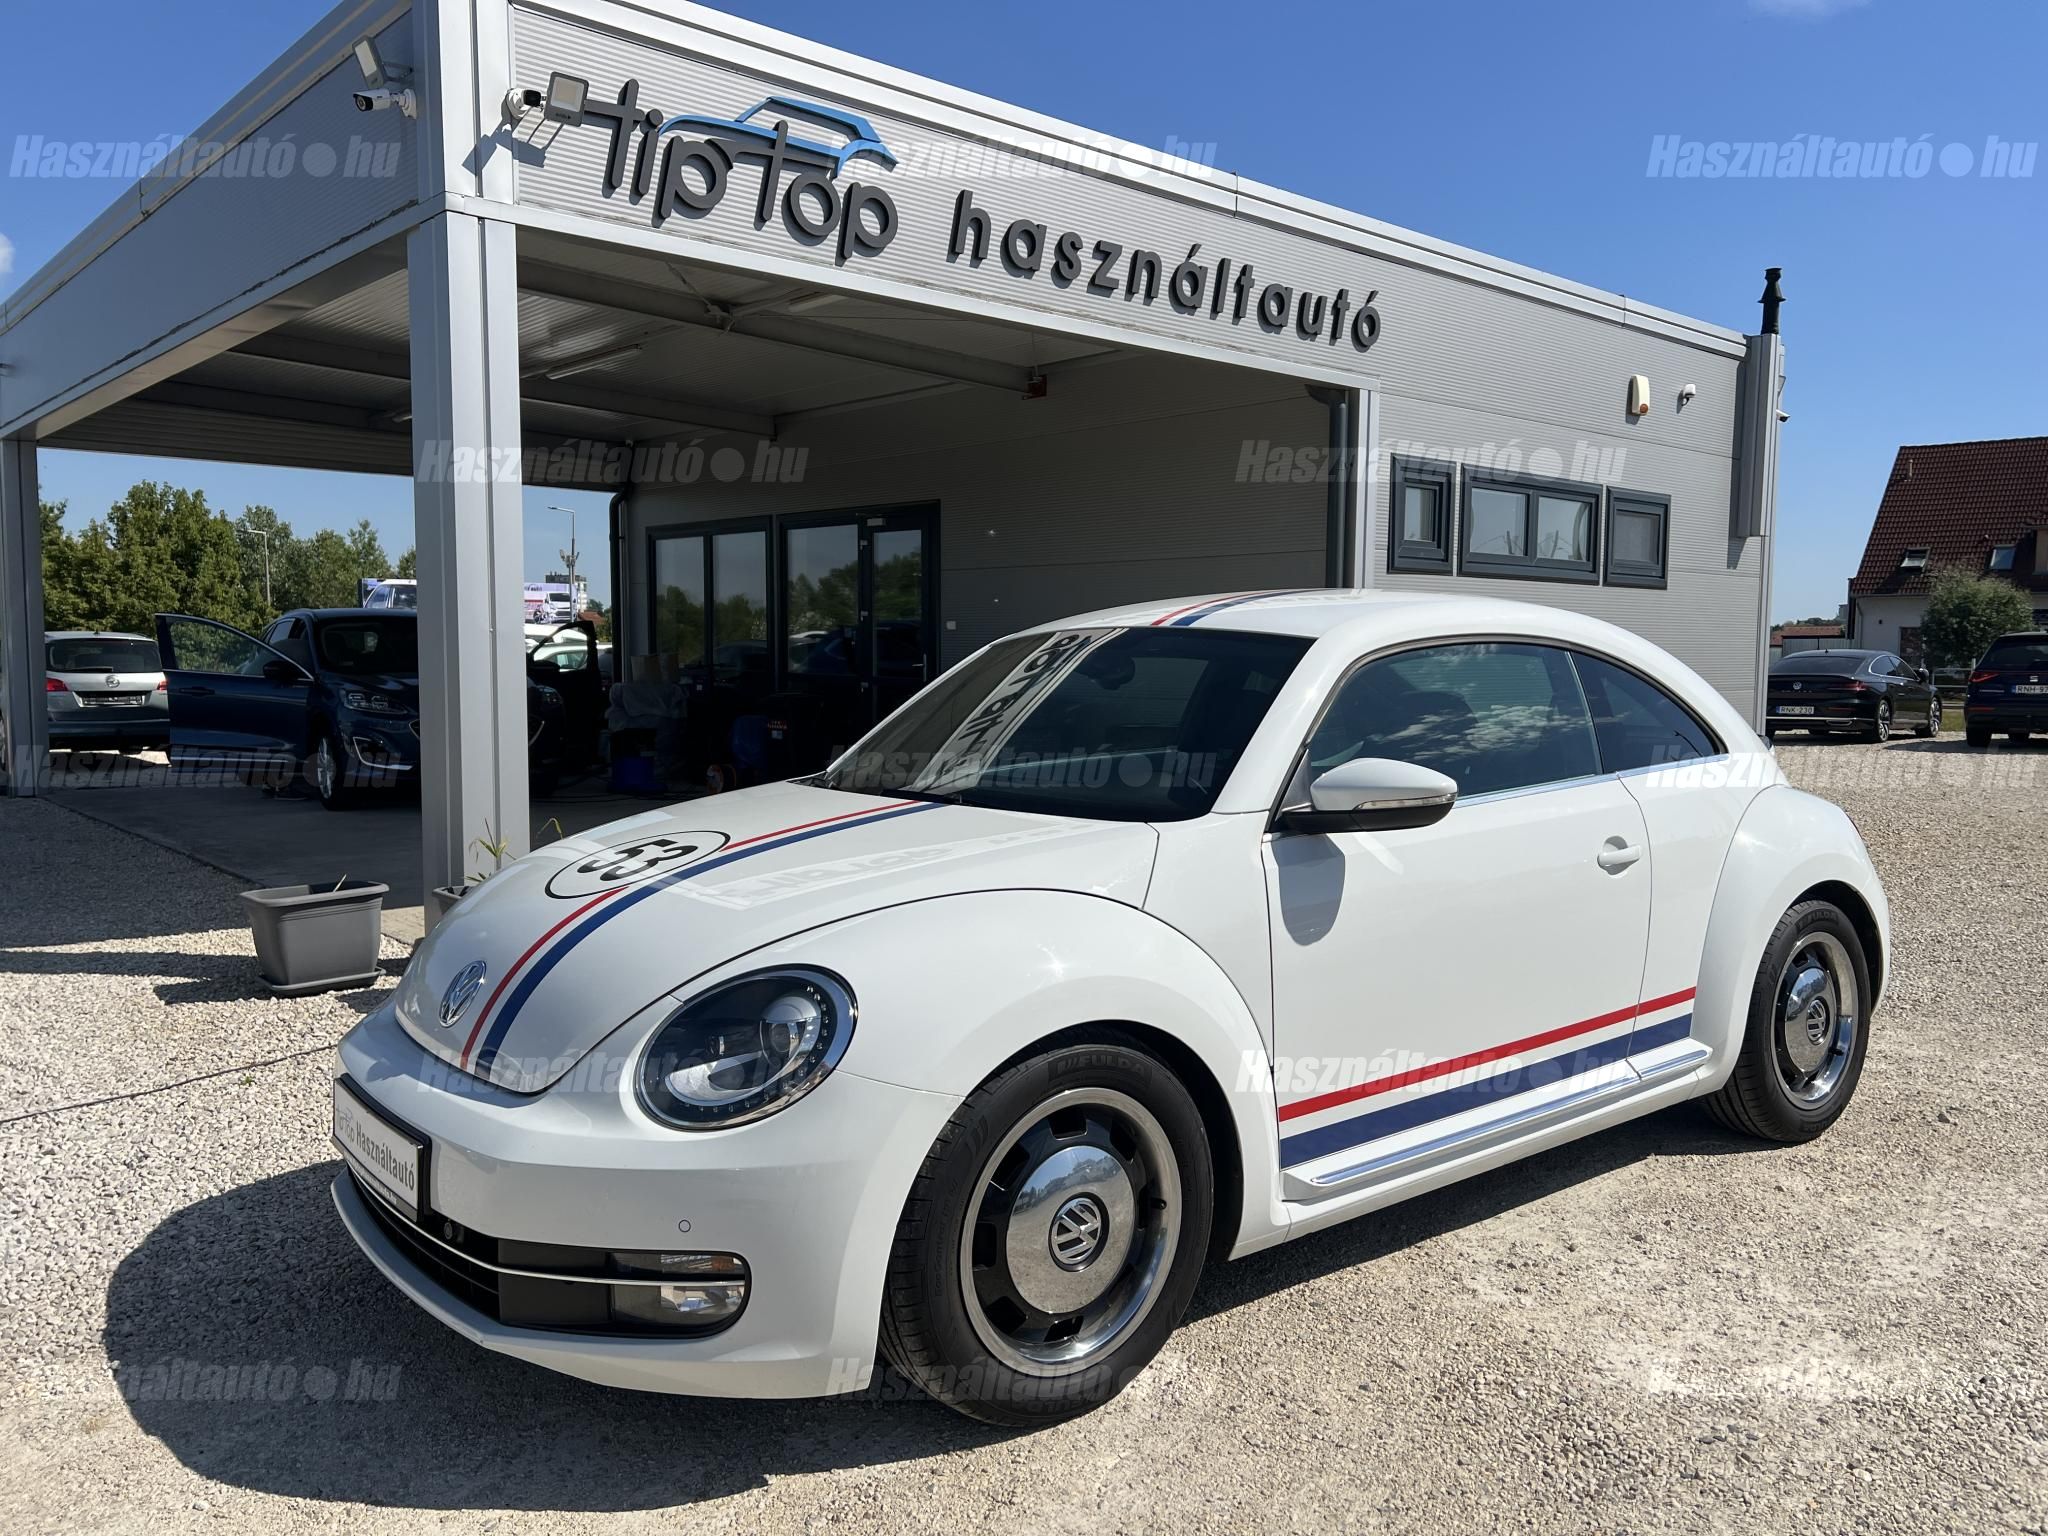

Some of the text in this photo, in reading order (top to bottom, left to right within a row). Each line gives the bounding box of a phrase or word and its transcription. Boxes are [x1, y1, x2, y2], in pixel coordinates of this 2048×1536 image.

[947, 189, 1381, 350] használtautó
[577, 838, 699, 882] 53
[356, 1119, 415, 1191] Használtautó
